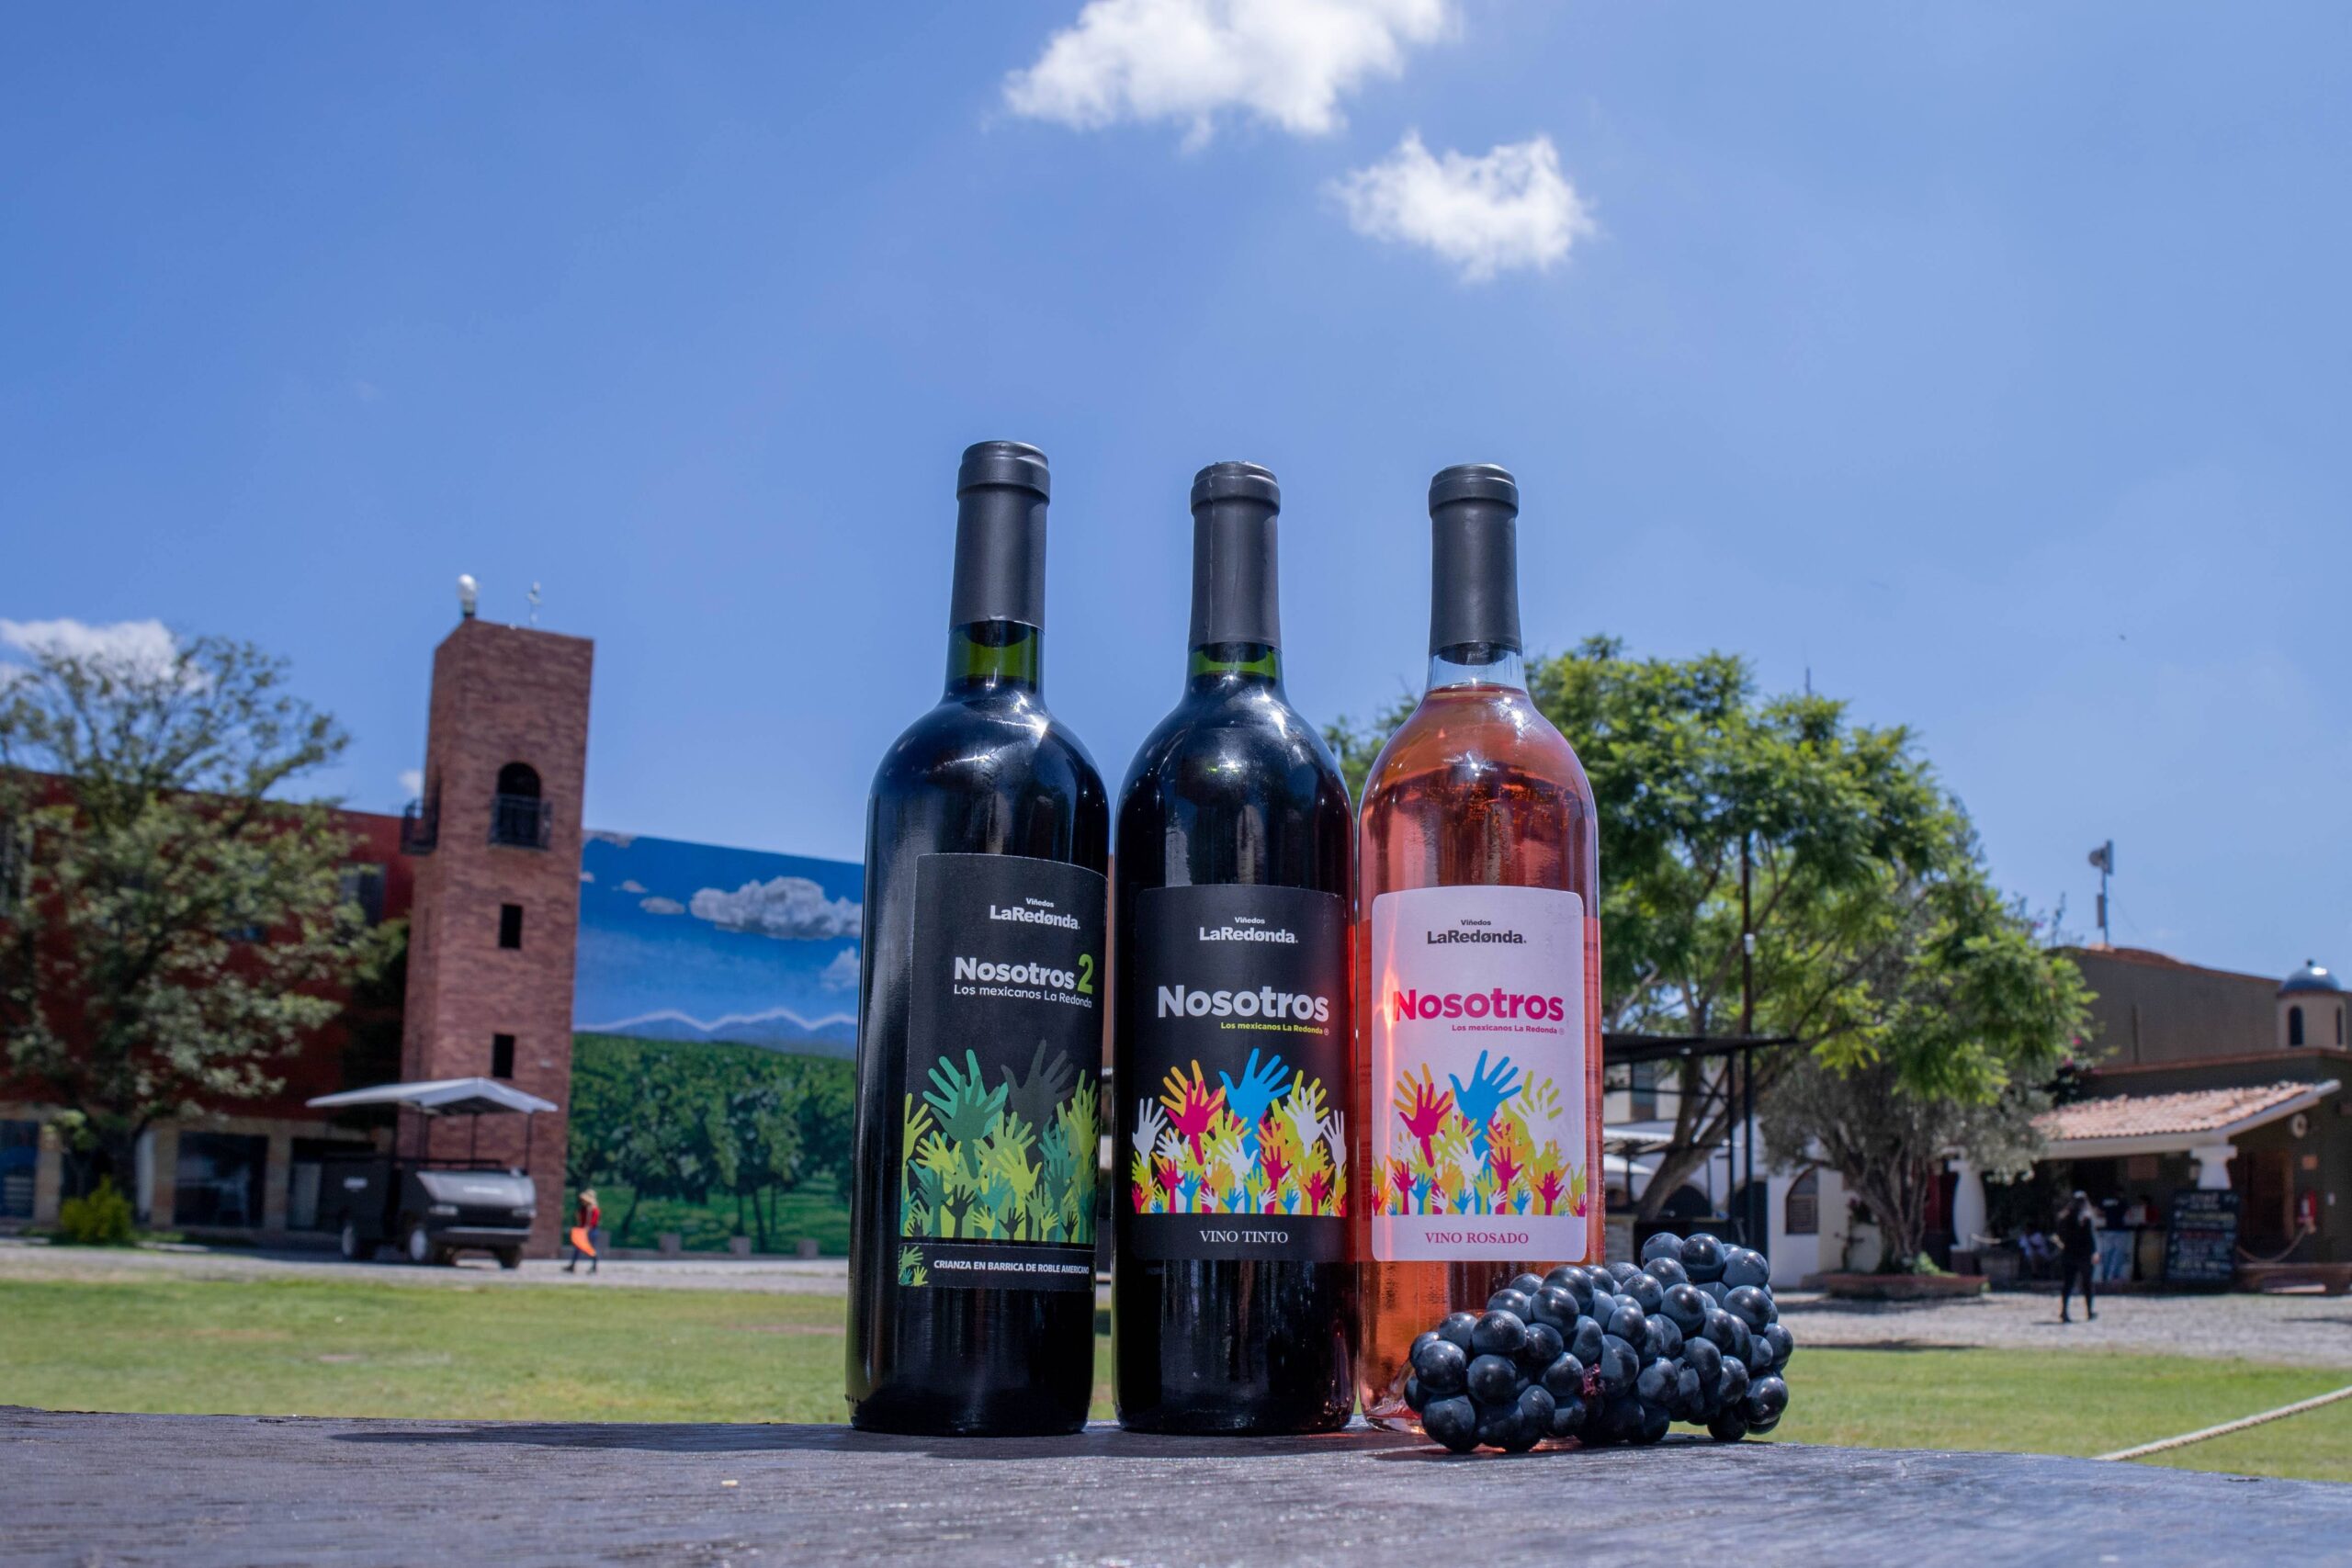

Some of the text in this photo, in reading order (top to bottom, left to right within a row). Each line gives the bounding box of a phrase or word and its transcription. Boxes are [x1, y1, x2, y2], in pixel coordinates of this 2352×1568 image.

[1026, 897, 1054, 908] Viñedos
[954, 985, 1092, 1008] Los mexicanos La Redonda
[1158, 985, 1329, 1021] Nosotros
[1393, 987, 1565, 1021] Nosotros
[1238, 1022, 1281, 1031] mexicanos
[1294, 1025, 1323, 1034] Redonda
[1200, 1231, 1288, 1243] VINO TINTO
[1425, 1232, 1529, 1244] VINO ROSADO
[933, 1259, 1090, 1275] CRIANZA EN BARRICA DE ROBLE AMERICANO
